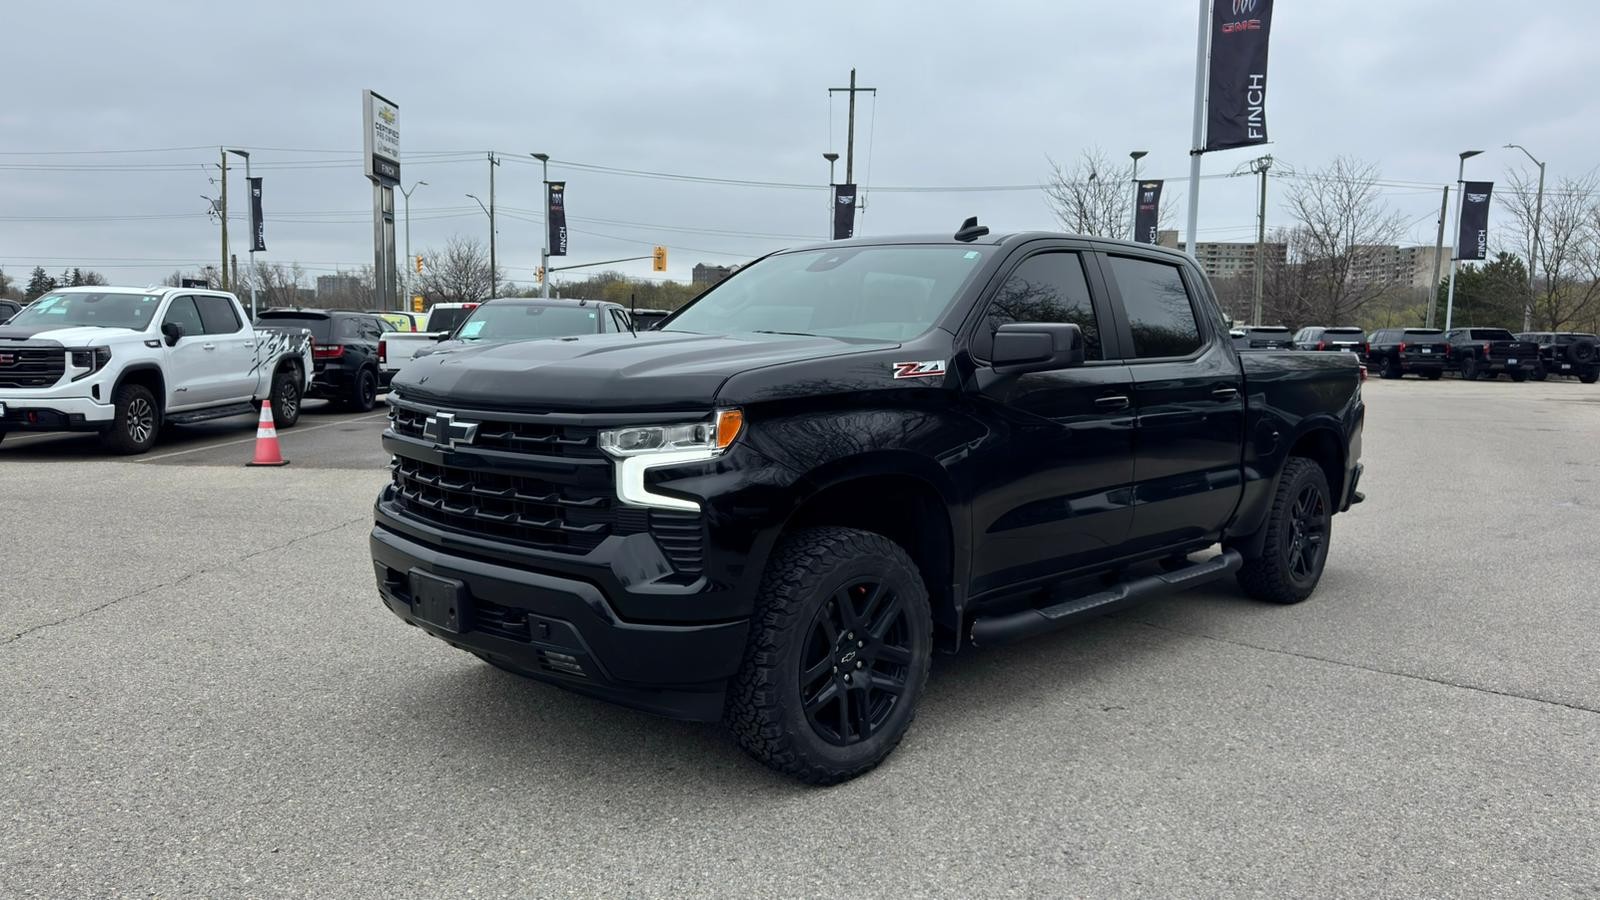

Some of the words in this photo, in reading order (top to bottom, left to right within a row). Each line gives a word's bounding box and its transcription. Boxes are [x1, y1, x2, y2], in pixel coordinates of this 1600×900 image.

[1222, 19, 1261, 33] GMC
[1247, 74, 1263, 139] FINCH
[559, 226, 567, 253] FINCH
[1478, 229, 1486, 257] FINCH
[893, 360, 945, 379] Z71
